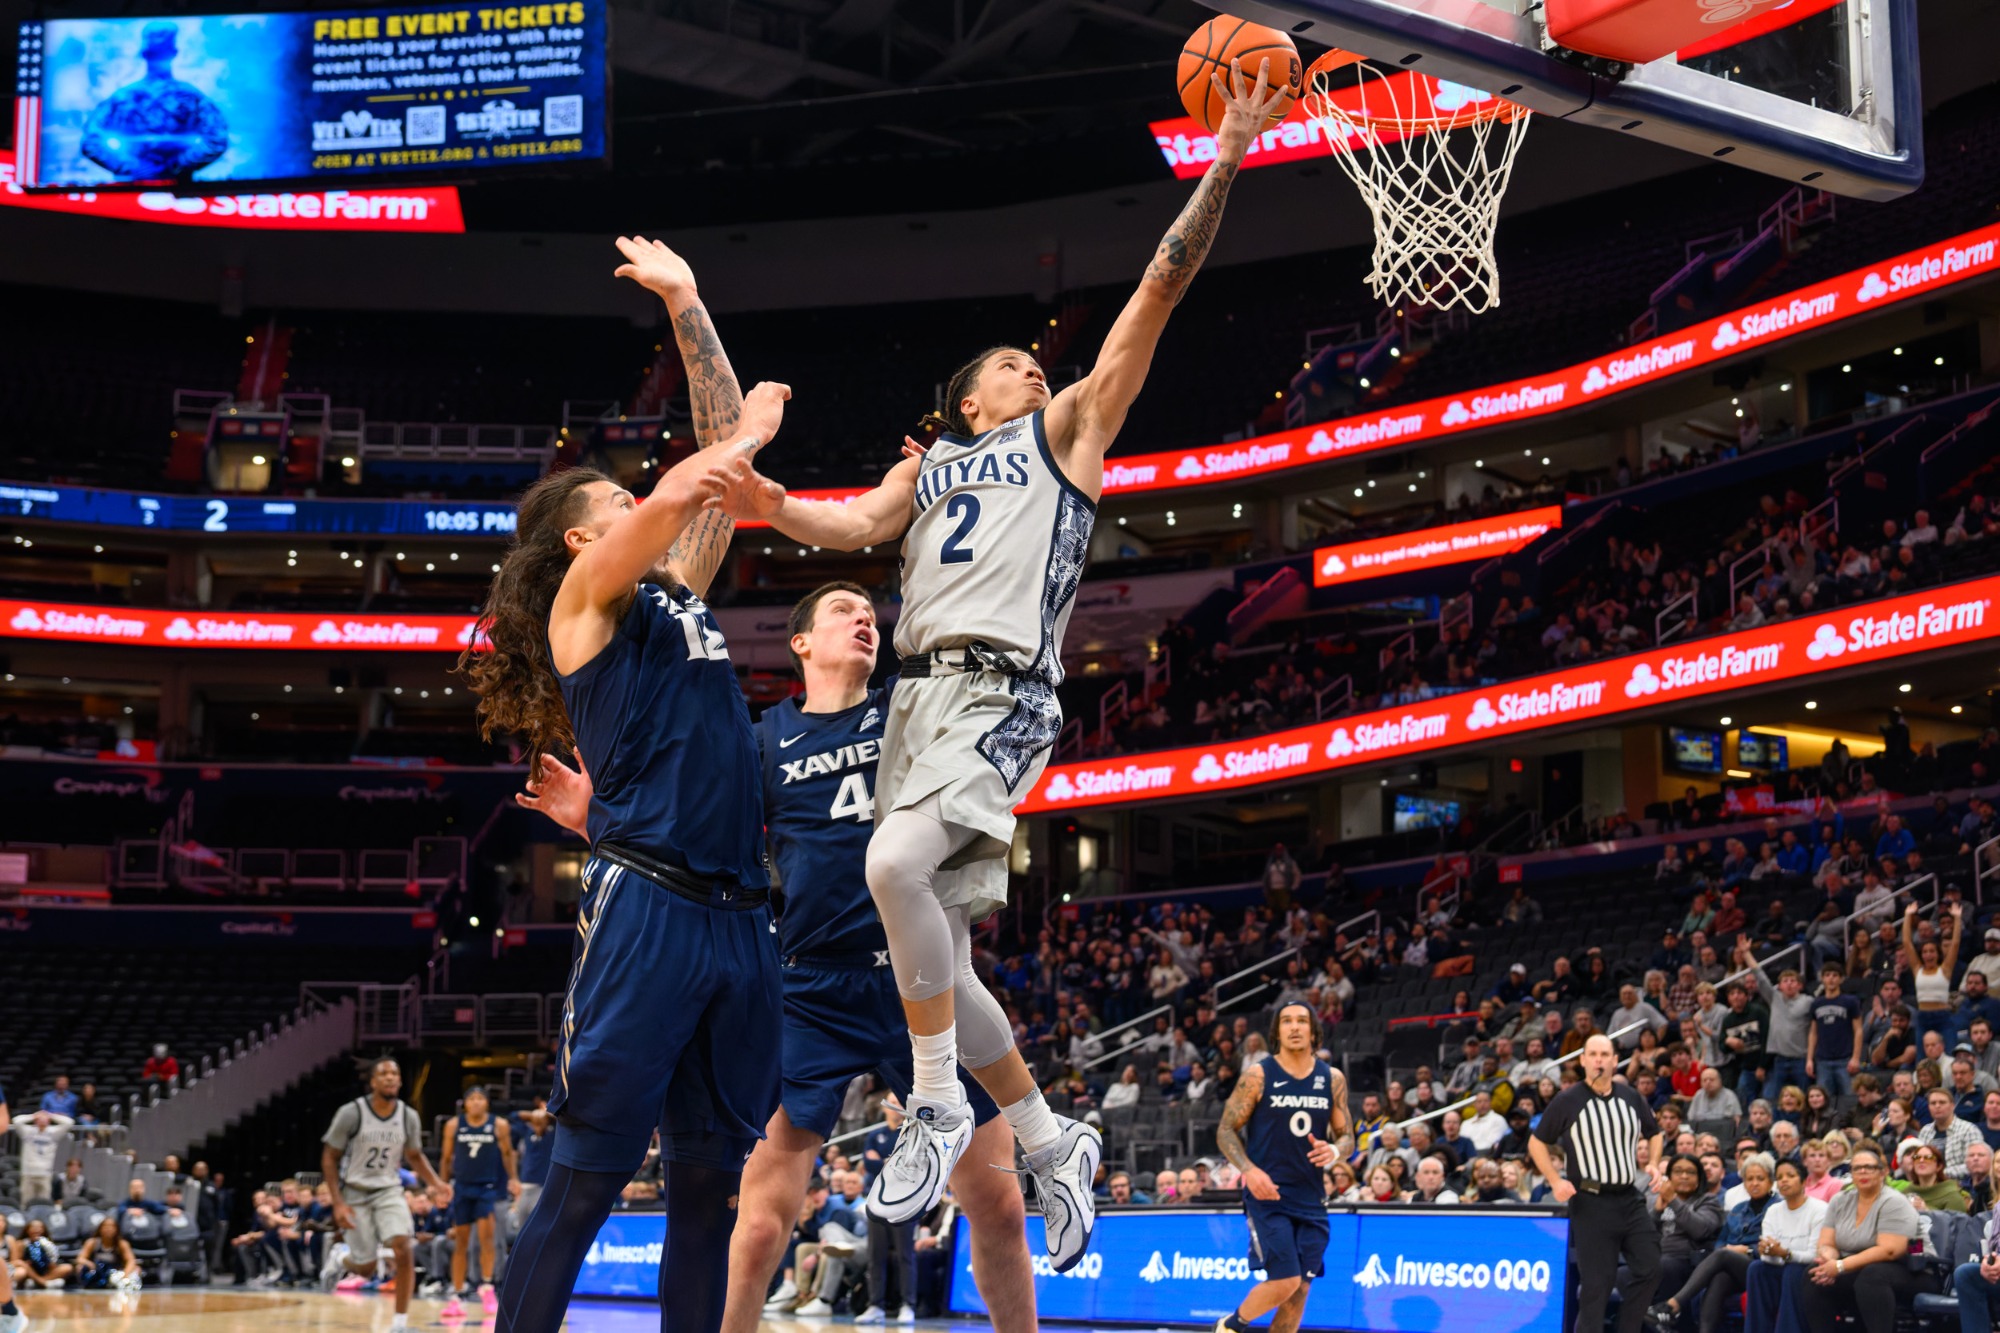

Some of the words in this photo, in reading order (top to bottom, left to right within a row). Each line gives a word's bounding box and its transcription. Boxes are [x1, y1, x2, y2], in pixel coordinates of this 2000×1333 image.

[315, 18, 379, 40] FREE
[386, 11, 470, 37] EVENT
[478, 2, 585, 31] TICKETS
[314, 40, 394, 57] Honoring
[398, 39, 437, 55] your
[441, 33, 503, 50] service
[506, 28, 545, 45] with
[548, 27, 584, 42] free
[312, 59, 362, 75] event
[365, 57, 425, 72] tickets
[428, 54, 454, 69] for
[457, 50, 511, 67] active
[515, 45, 582, 62] military
[393, 73, 461, 88] veterans
[478, 66, 516, 82] their
[915, 452, 1029, 512] HOYAS
[204, 500, 228, 532] 2
[425, 511, 479, 531] 10:05
[483, 512, 518, 532] PM
[939, 493, 981, 565] 2
[1352, 554, 1373, 568] Like
[1452, 536, 1478, 550] State
[1480, 531, 1507, 545] Farm
[674, 613, 730, 661] 12
[830, 772, 875, 823] 4
[872, 950, 890, 967] X
[1270, 1095, 1329, 1109] XAVIER
[1290, 1111, 1312, 1137] 0
[366, 1147, 391, 1169] 25
[468, 1142, 482, 1158] 7
[1172, 1251, 1250, 1281] Invesco
[1395, 1255, 1491, 1288] Invesco
[1494, 1259, 1550, 1292] QQQ
